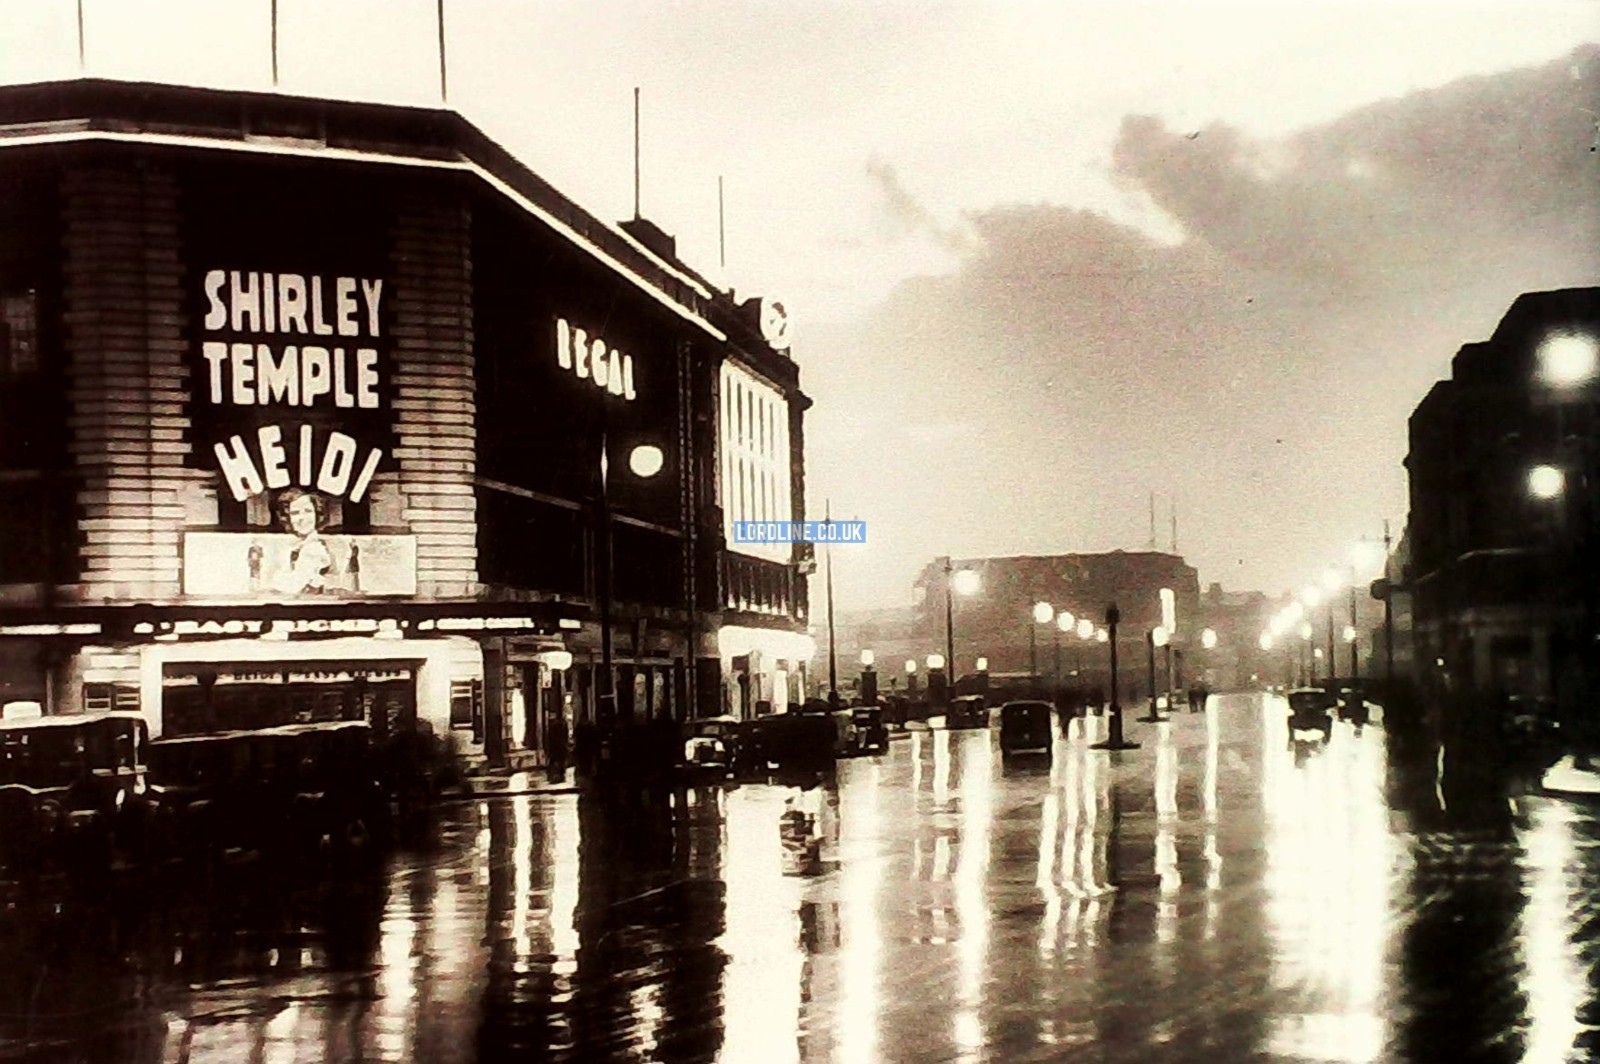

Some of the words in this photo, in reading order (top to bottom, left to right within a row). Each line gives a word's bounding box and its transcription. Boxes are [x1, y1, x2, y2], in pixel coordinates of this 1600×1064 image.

[204, 269, 383, 337] SHIRLEY
[202, 341, 380, 409] TEMPLE
[213, 424, 383, 504] HEIDI
